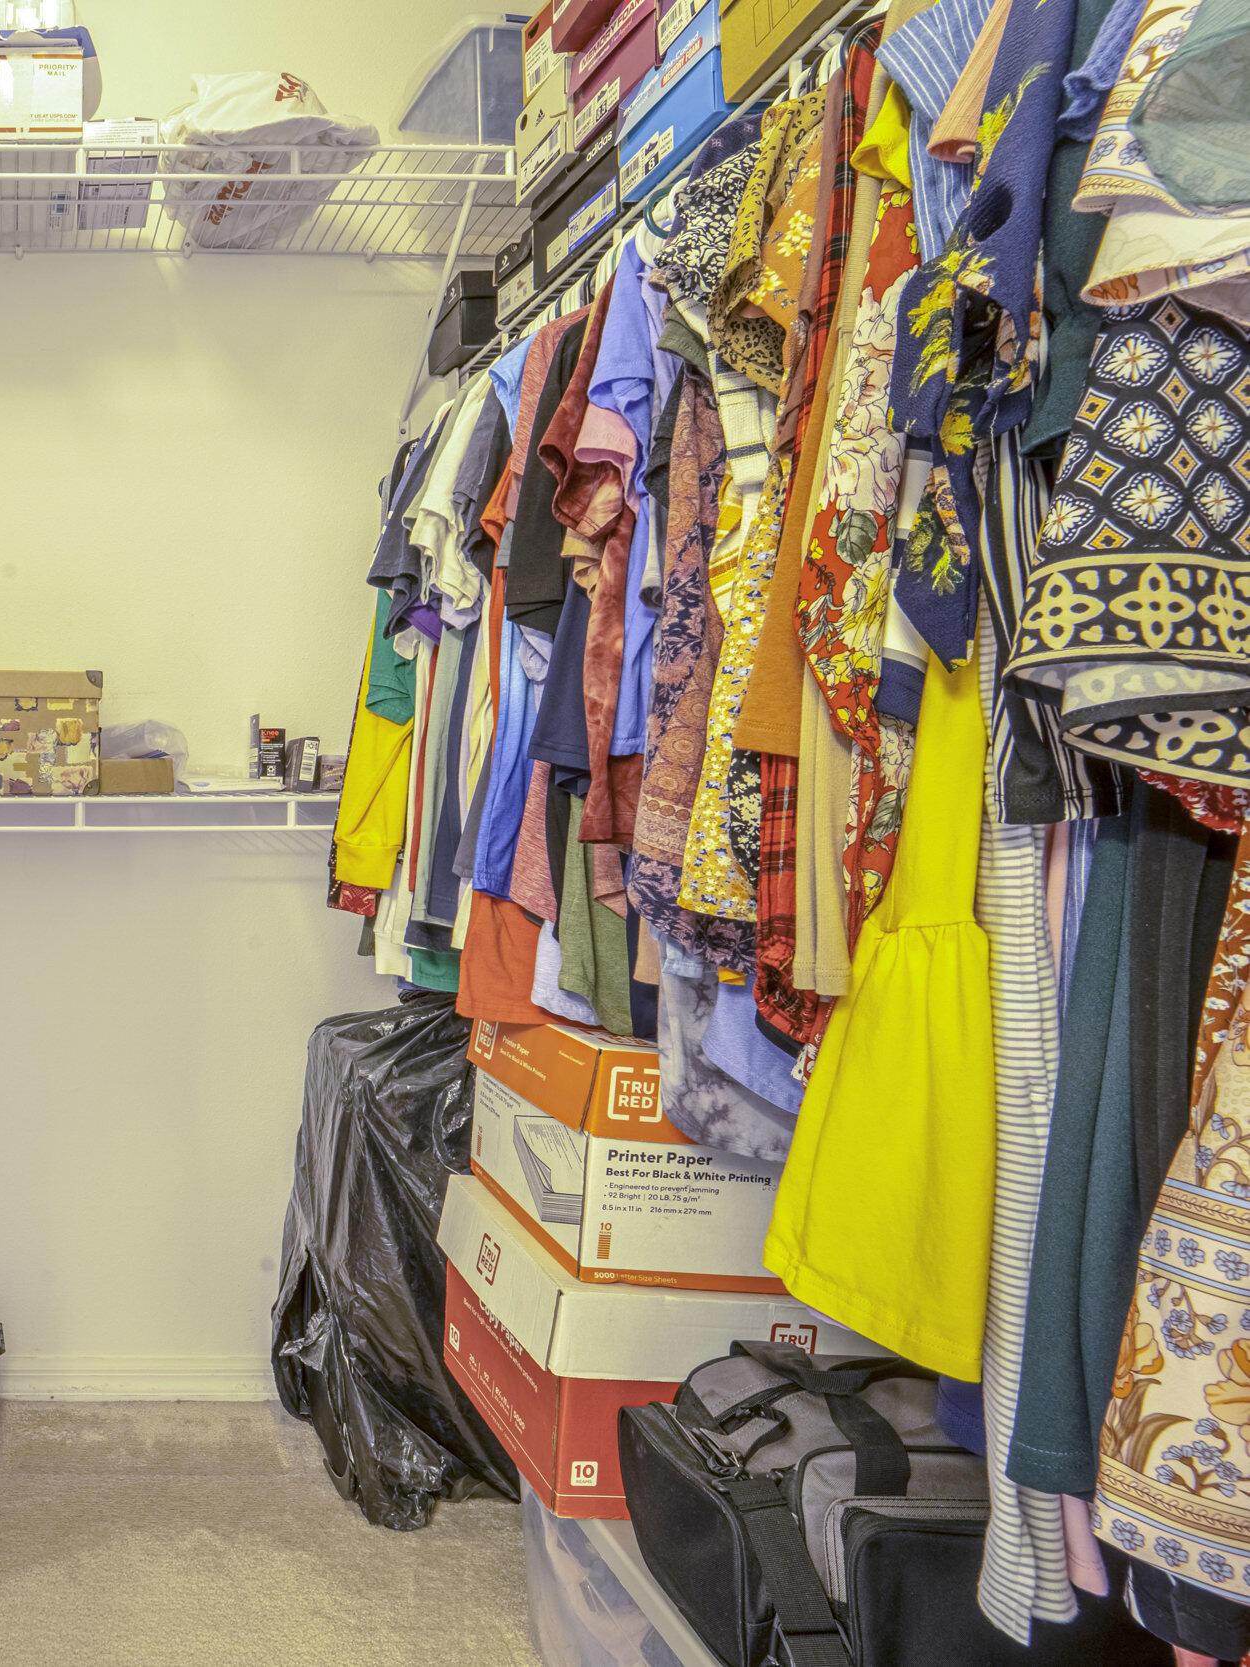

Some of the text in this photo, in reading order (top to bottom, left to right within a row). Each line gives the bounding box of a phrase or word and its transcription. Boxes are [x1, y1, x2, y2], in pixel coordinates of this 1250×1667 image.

[586, 130, 612, 162] adidas
[648, 157, 655, 171] 8
[482, 1021, 494, 1036] TRU
[479, 1033, 492, 1047] RED
[502, 1035, 530, 1056] Printer Paper
[620, 1080, 655, 1094] TRU
[618, 1095, 653, 1108] RED
[608, 1149, 713, 1168] Printer Paper
[606, 1168, 771, 1185] Best For Black & White Printing
[609, 1183, 650, 1191] Engineered
[689, 1187, 719, 1195] jamming
[619, 1192, 640, 1200] Bright
[600, 1222, 612, 1231] 10
[484, 1245, 496, 1263] TRU
[481, 1255, 493, 1272] RED
[654, 1276, 677, 1284] Sheets
[479, 1298, 500, 1329] Copy
[451, 1326, 458, 1342] 10
[779, 1334, 808, 1345] TRU
[575, 1465, 594, 1478] 10
